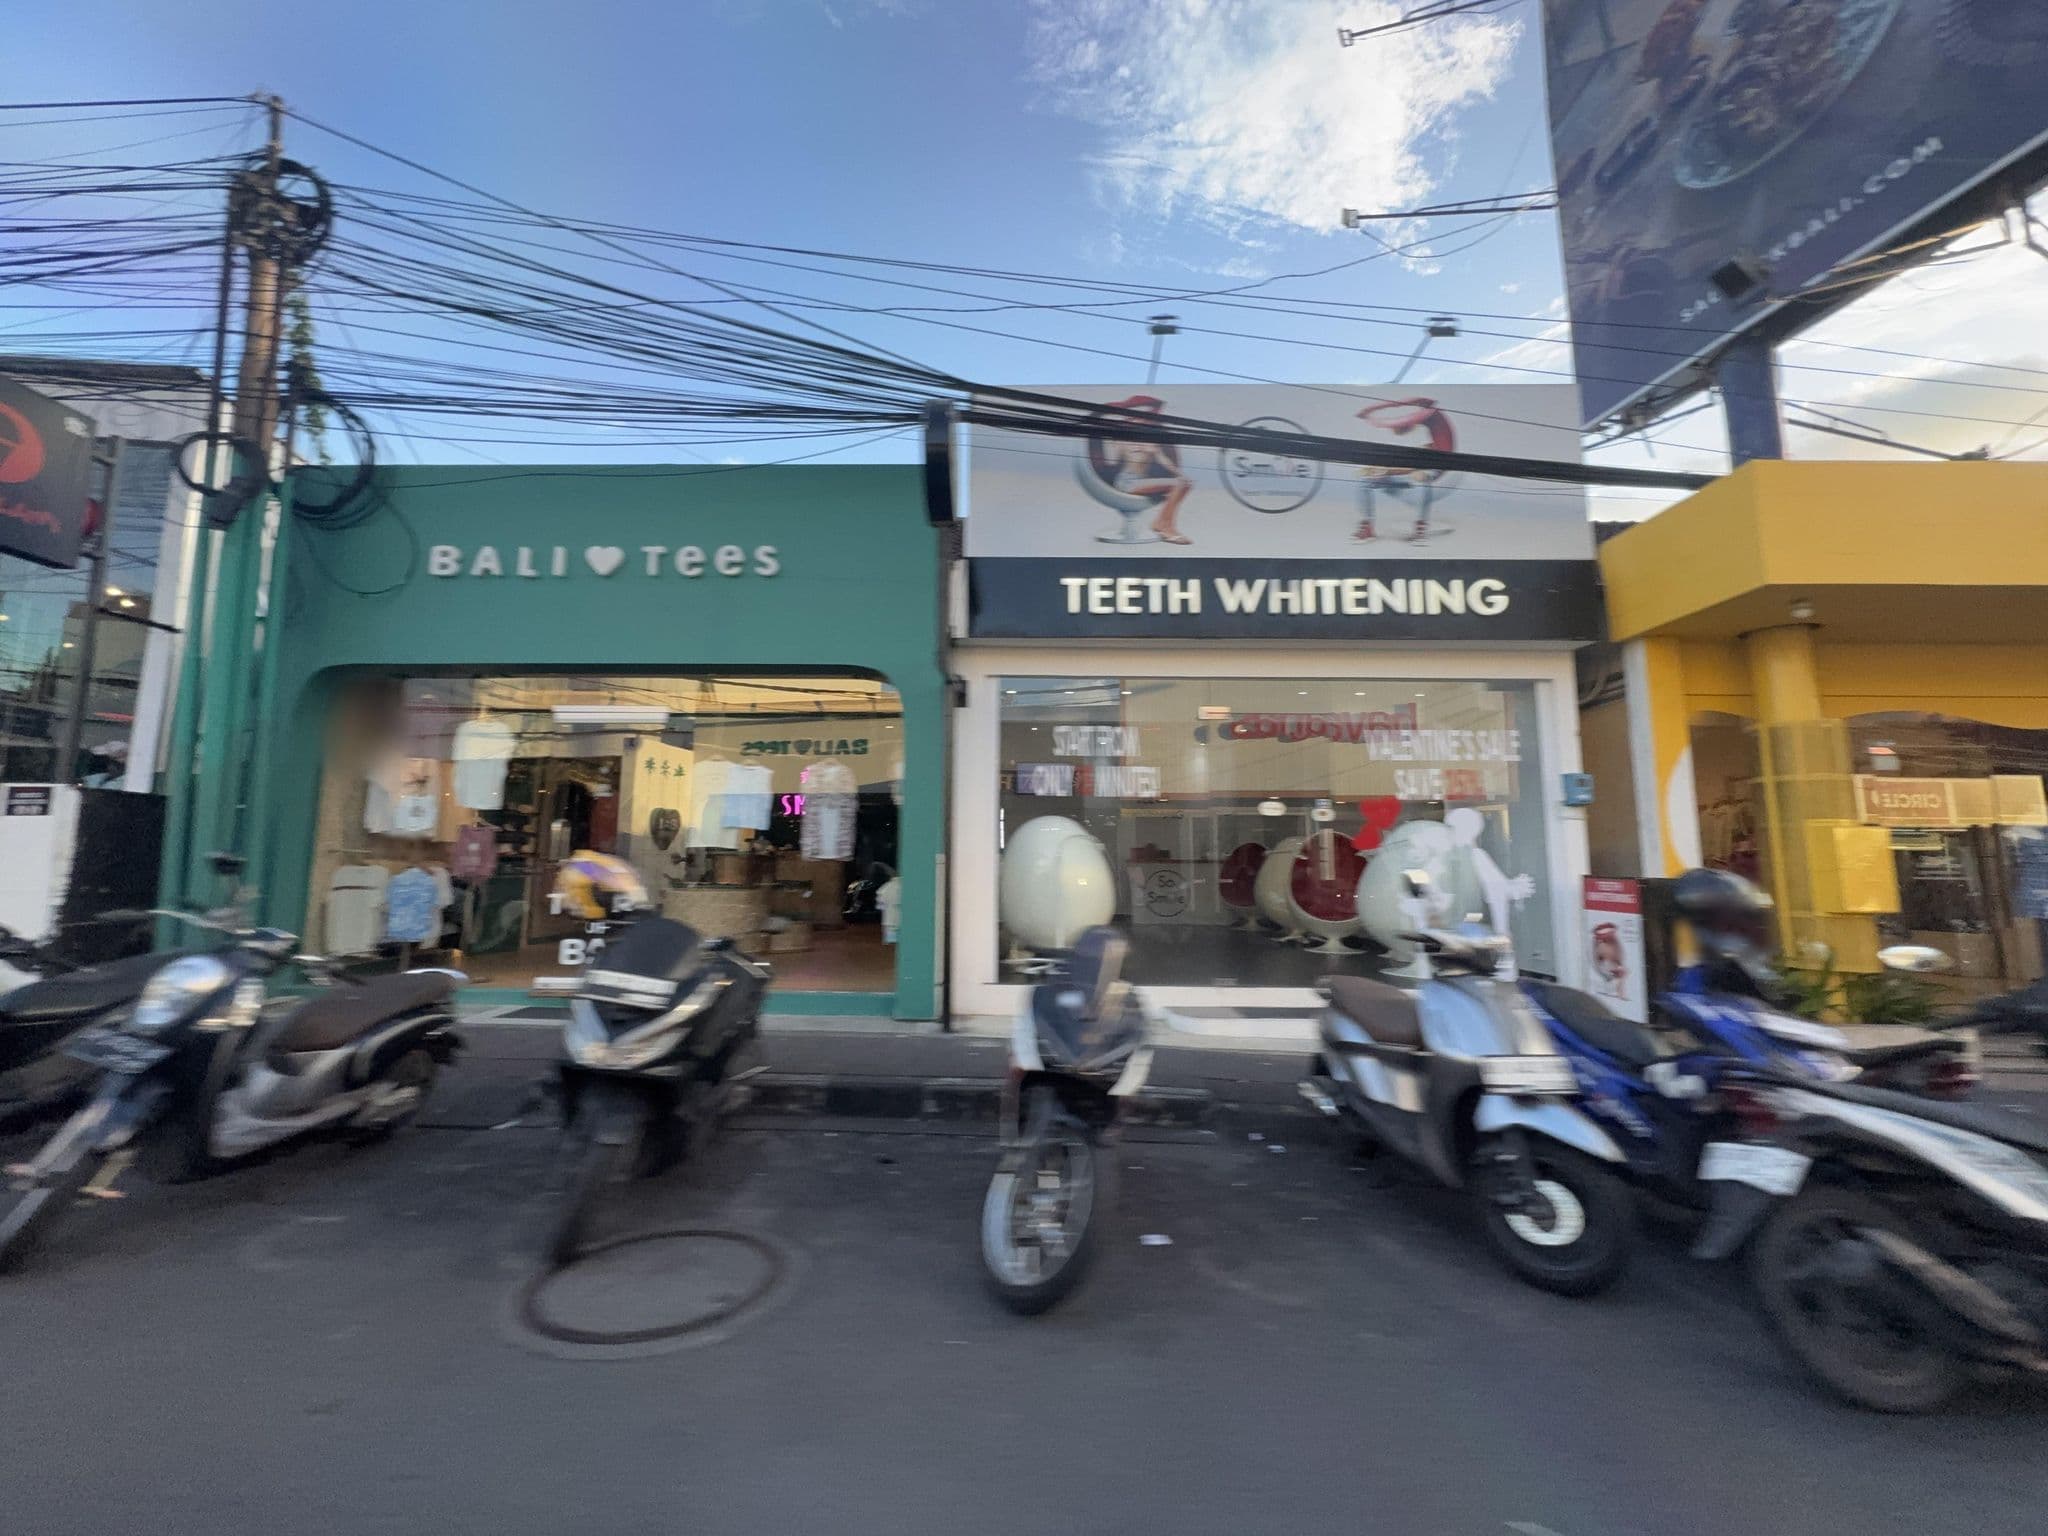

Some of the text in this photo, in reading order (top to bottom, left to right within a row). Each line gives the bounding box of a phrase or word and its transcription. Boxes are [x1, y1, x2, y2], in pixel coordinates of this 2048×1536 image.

[428, 545, 781, 577] BALI Tees
[1060, 577, 1509, 616] TEETH WHITENING
